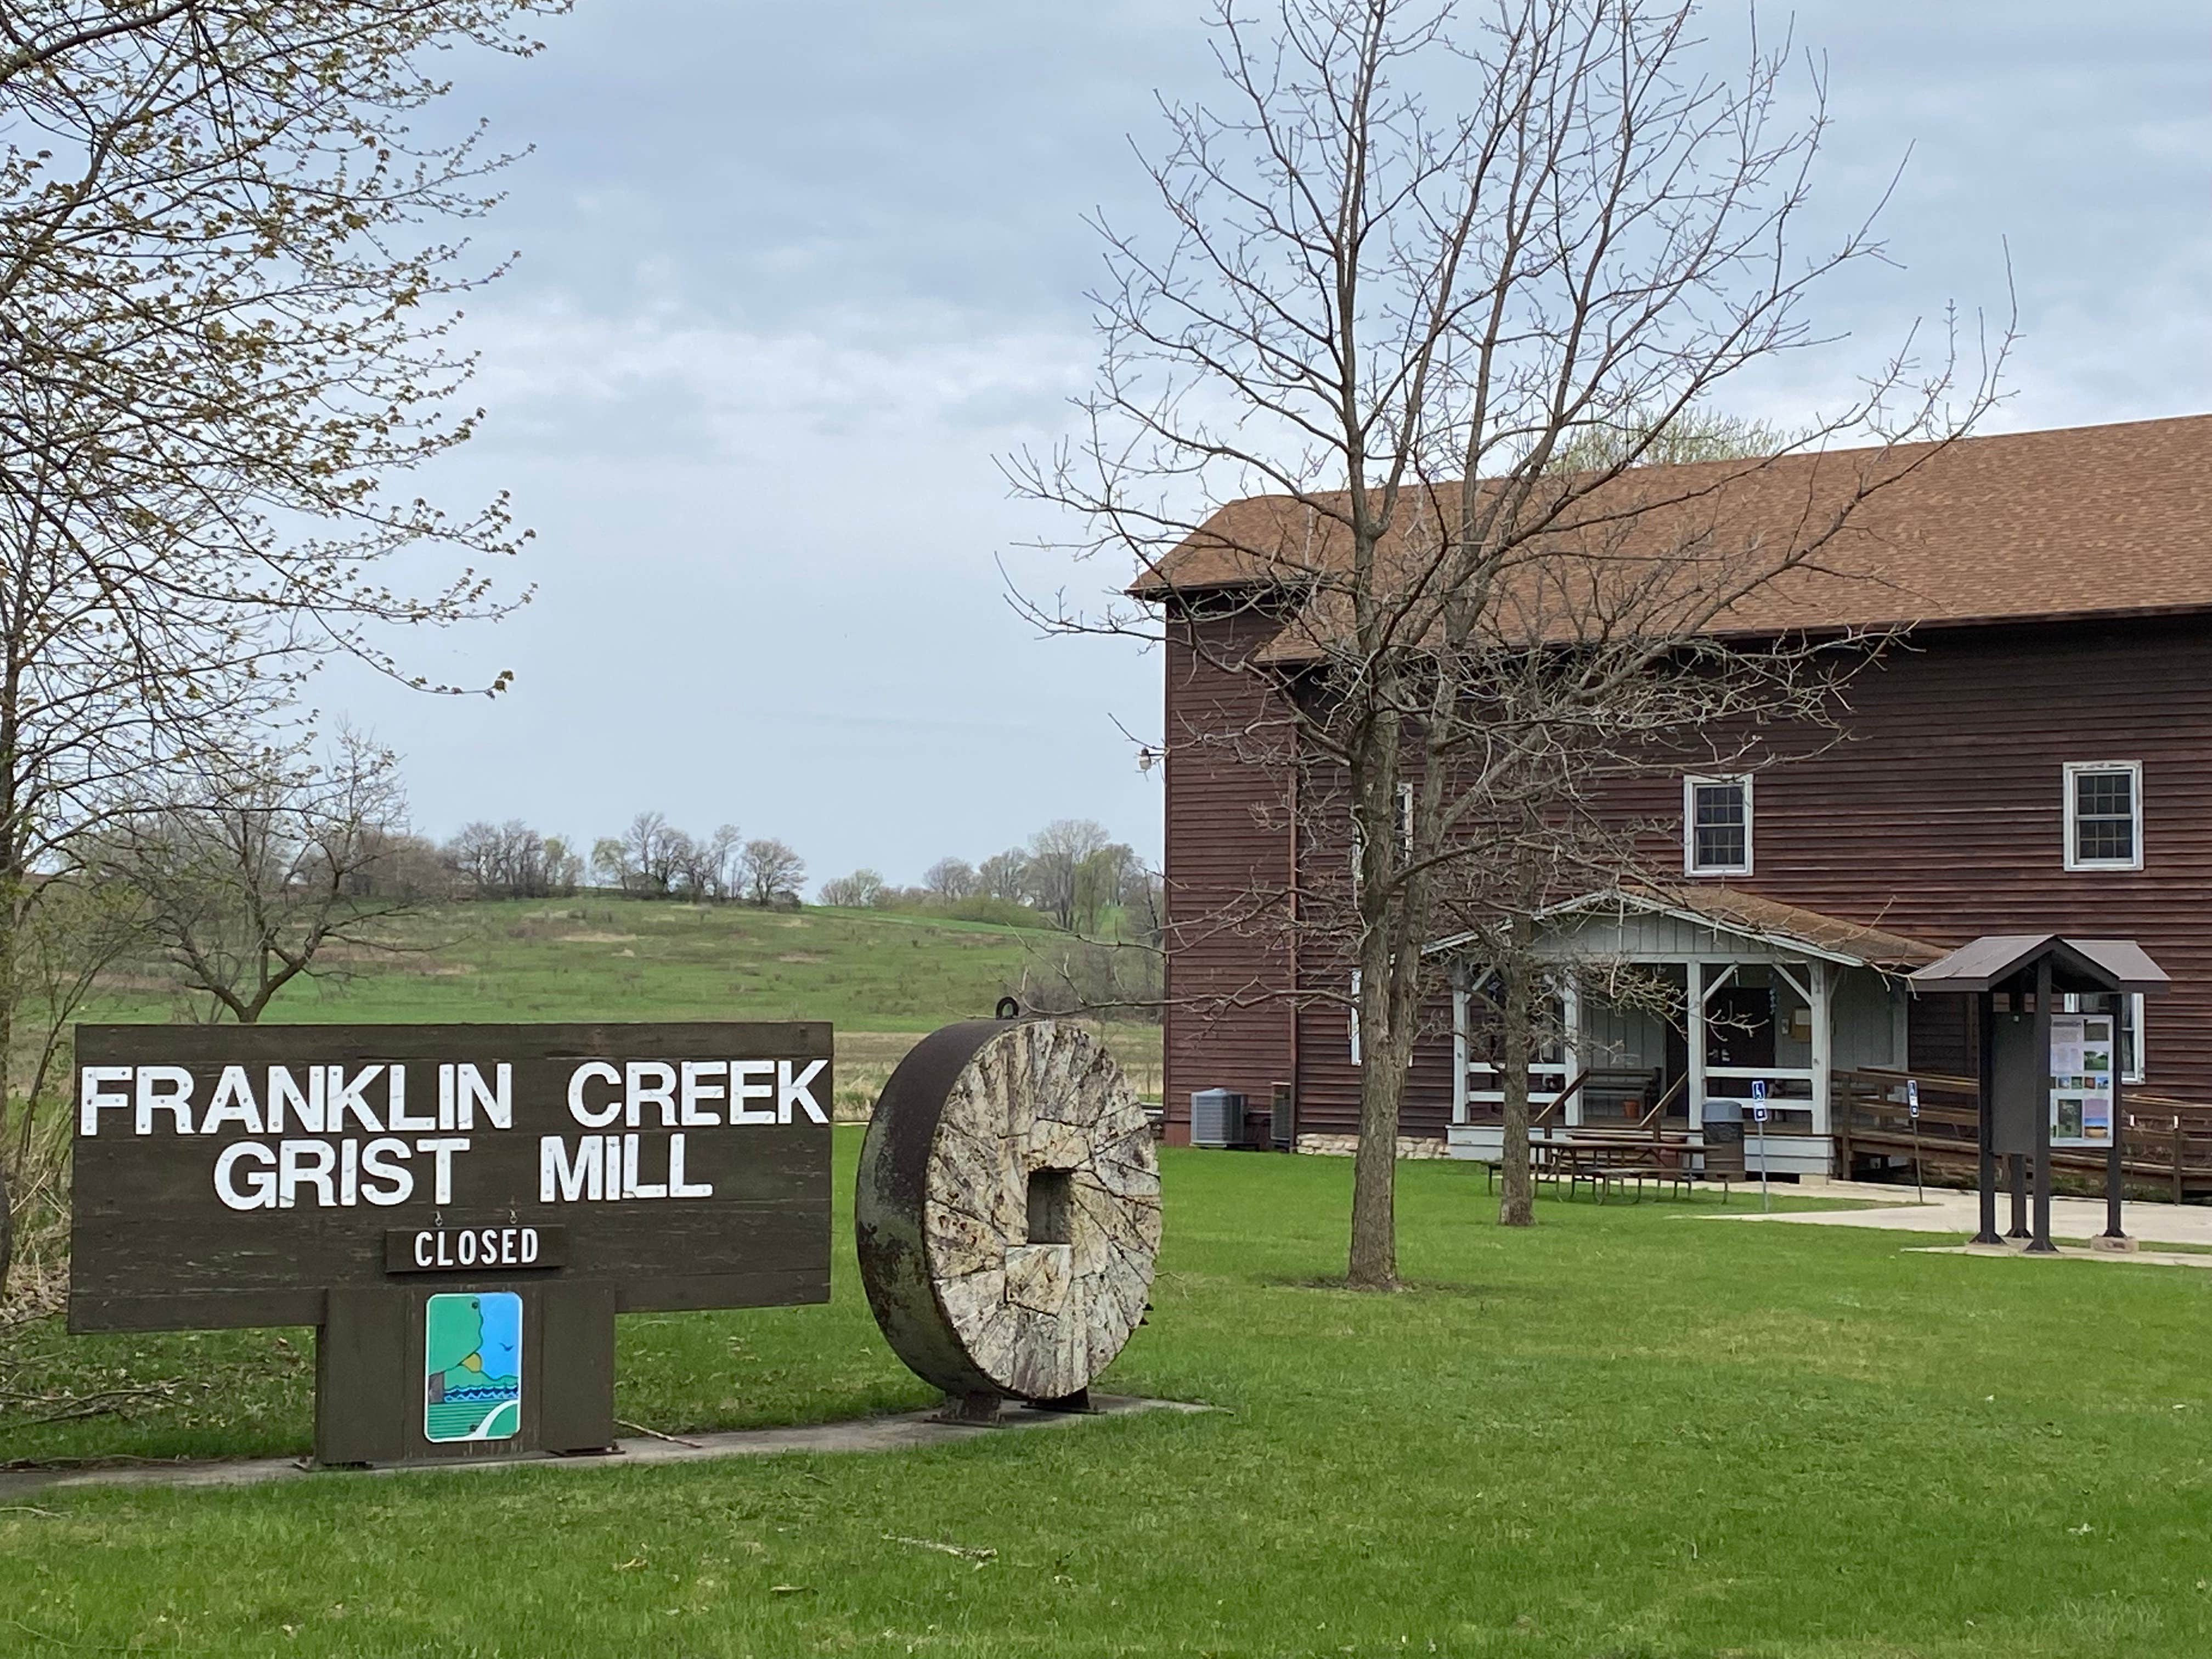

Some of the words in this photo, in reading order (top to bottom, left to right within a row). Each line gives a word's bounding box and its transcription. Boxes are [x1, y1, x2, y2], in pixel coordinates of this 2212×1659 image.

[81, 1063, 512, 1136] FRANKLIN
[567, 1059, 829, 1127] CREEK
[214, 1138, 470, 1210] GRIST
[540, 1133, 713, 1203] MILL
[415, 1228, 539, 1266] CLOSED
